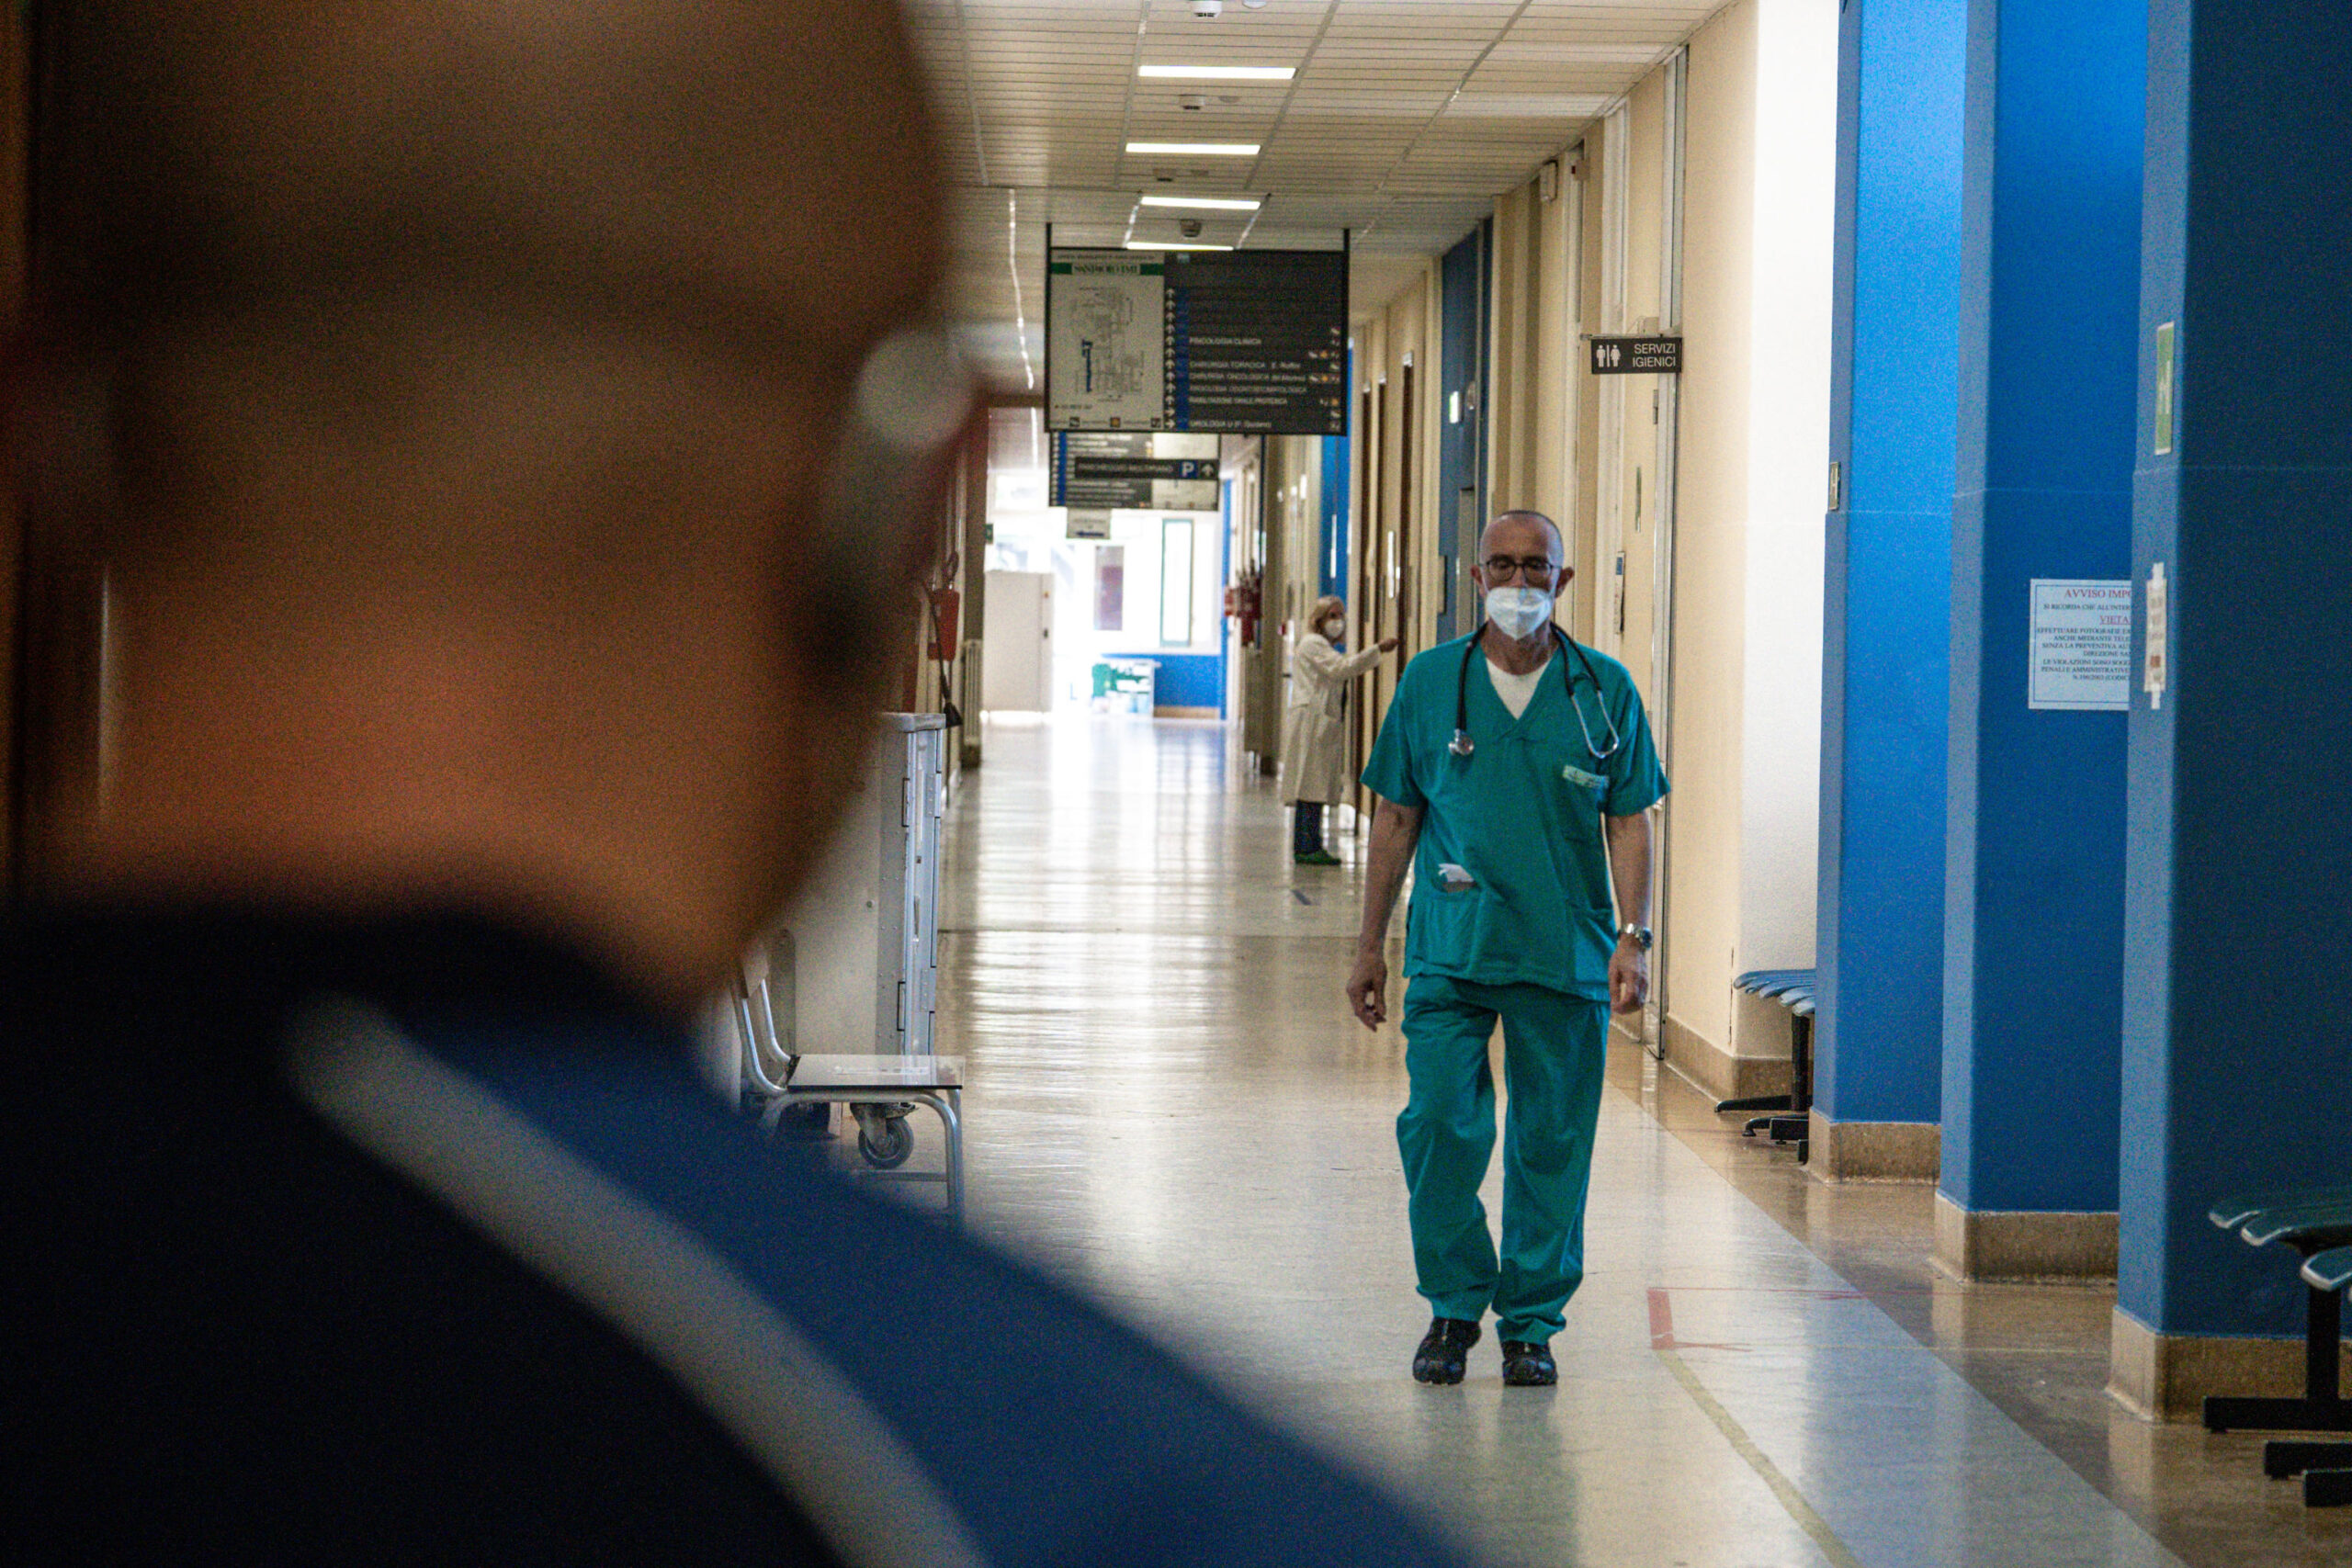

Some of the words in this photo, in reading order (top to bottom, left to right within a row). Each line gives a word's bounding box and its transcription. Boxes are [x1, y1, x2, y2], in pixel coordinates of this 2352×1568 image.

[1634, 343, 1676, 355] SERVIZI
[1633, 356, 1676, 367] IGIENICI
[1182, 462, 1194, 477] P
[2065, 589, 2106, 599] AVVISO
